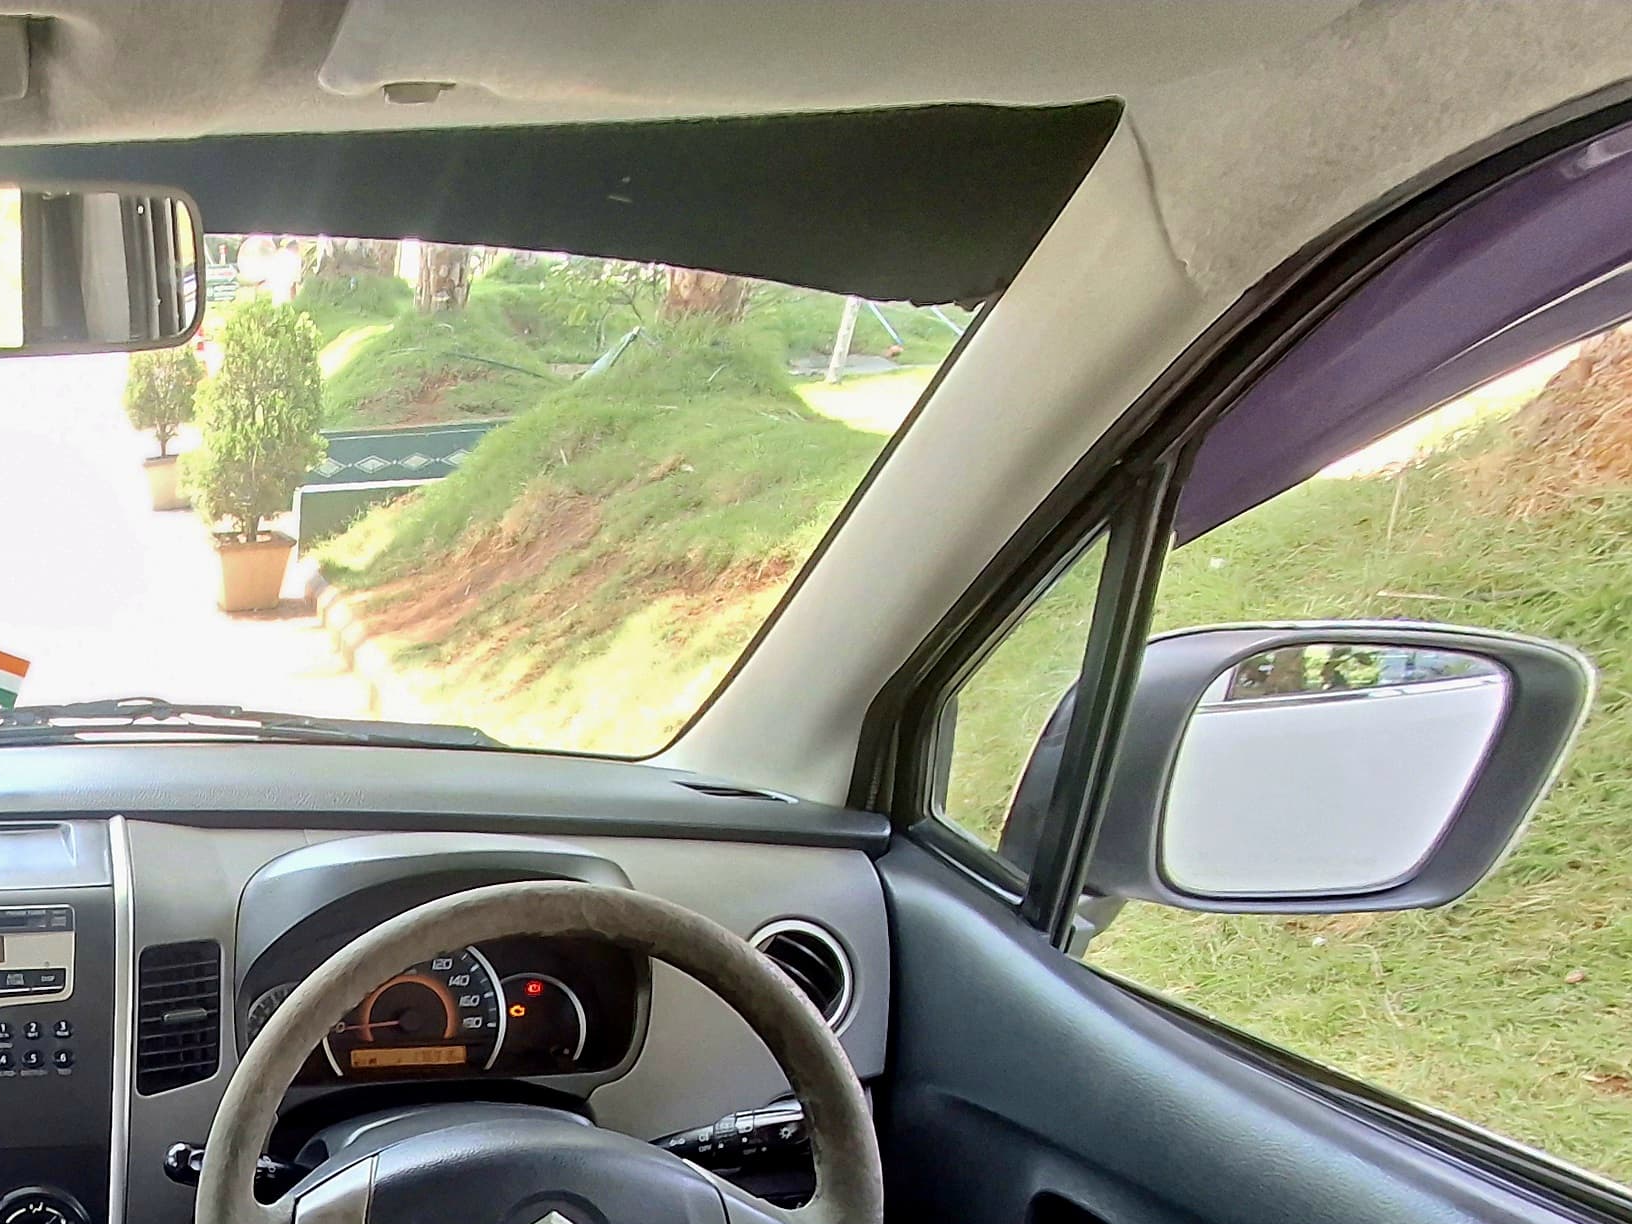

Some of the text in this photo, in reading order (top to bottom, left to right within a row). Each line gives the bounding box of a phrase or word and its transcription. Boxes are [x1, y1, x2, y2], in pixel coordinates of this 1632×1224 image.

[432, 958, 453, 970] 120
[448, 974, 470, 986] 140
[0, 1023, 7, 1032] 1
[30, 1022, 37, 1032] 2
[59, 1021, 67, 1031] 3
[0, 1055, 7, 1064] 4
[30, 1053, 37, 1063] 5
[59, 1053, 67, 1062] 6
